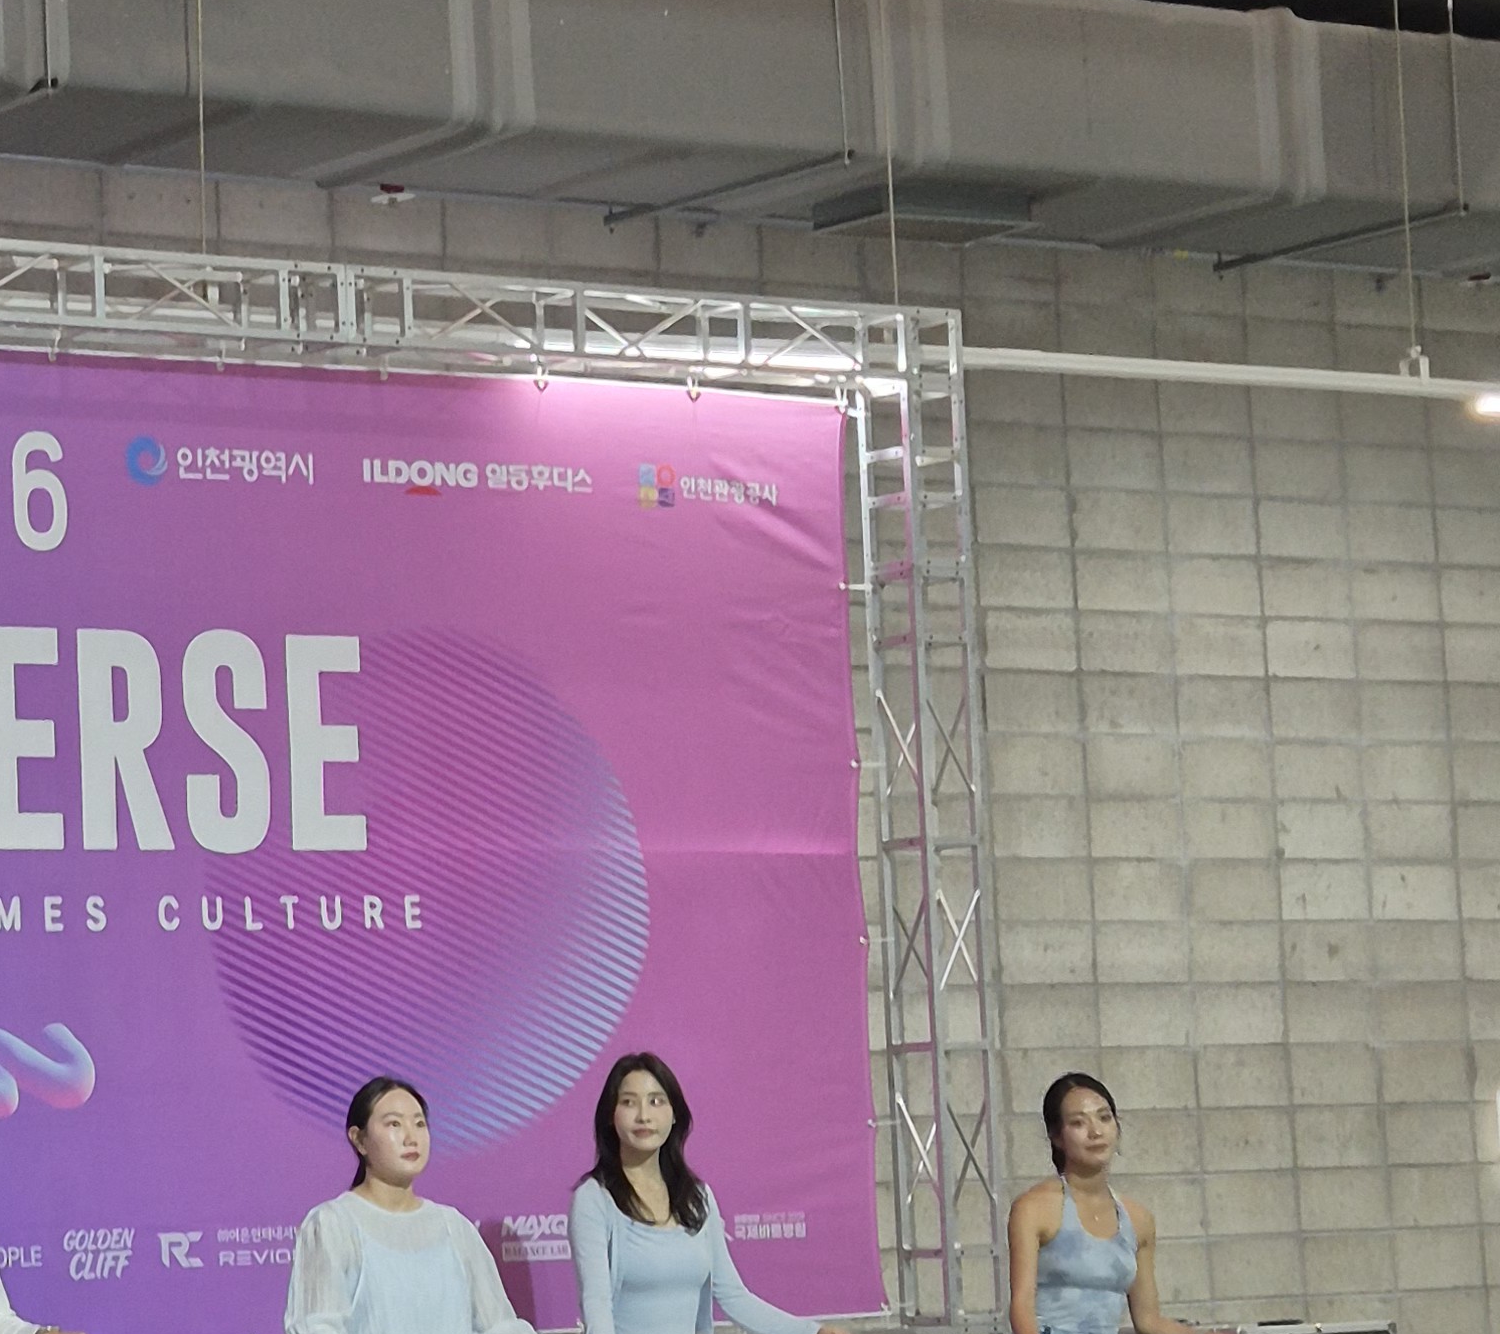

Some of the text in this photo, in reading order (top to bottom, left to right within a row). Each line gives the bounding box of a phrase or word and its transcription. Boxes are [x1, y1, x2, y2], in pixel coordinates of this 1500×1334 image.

[177, 446, 314, 485] 인천광역시
[363, 458, 593, 493] ILDONG 일동후디스
[679, 475, 777, 507] 인천관광공사
[157, 894, 425, 931] CULTURE
[63, 1227, 135, 1252] GOLDEN
[69, 1249, 133, 1281] CLIFF
[219, 1248, 297, 1267] REVIO
